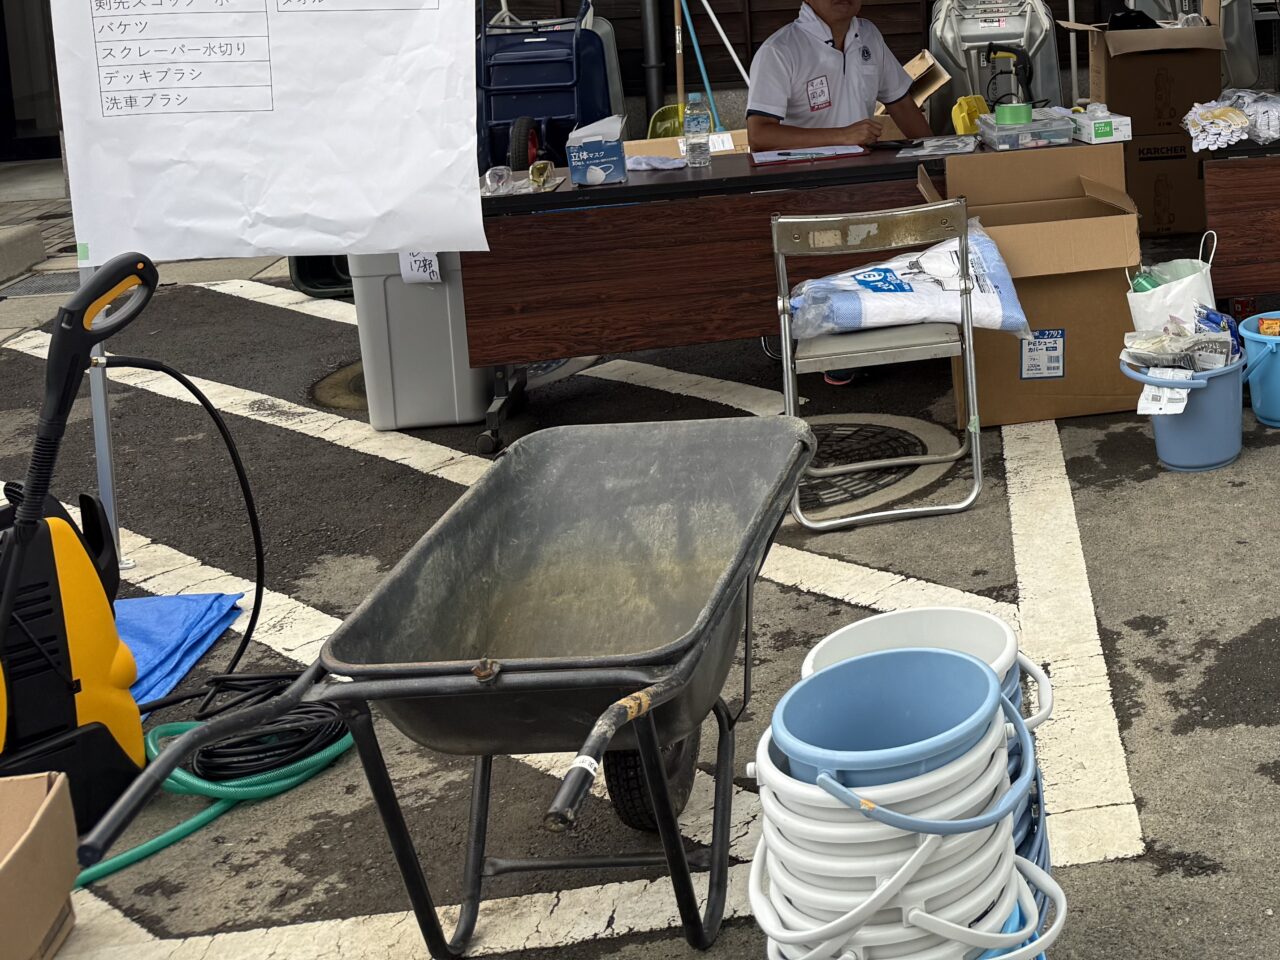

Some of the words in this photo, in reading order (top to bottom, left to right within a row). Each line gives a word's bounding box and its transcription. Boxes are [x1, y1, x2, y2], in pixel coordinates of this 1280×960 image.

[96, 16, 147, 34] バケツ
[100, 40, 245, 59] スクレーパー水切り
[102, 66, 202, 85] デッキブラシ
[104, 91, 187, 110] 洗車ブラシ
[570, 151, 605, 160] 立体マスク
[1043, 330, 1062, 338] 2792
